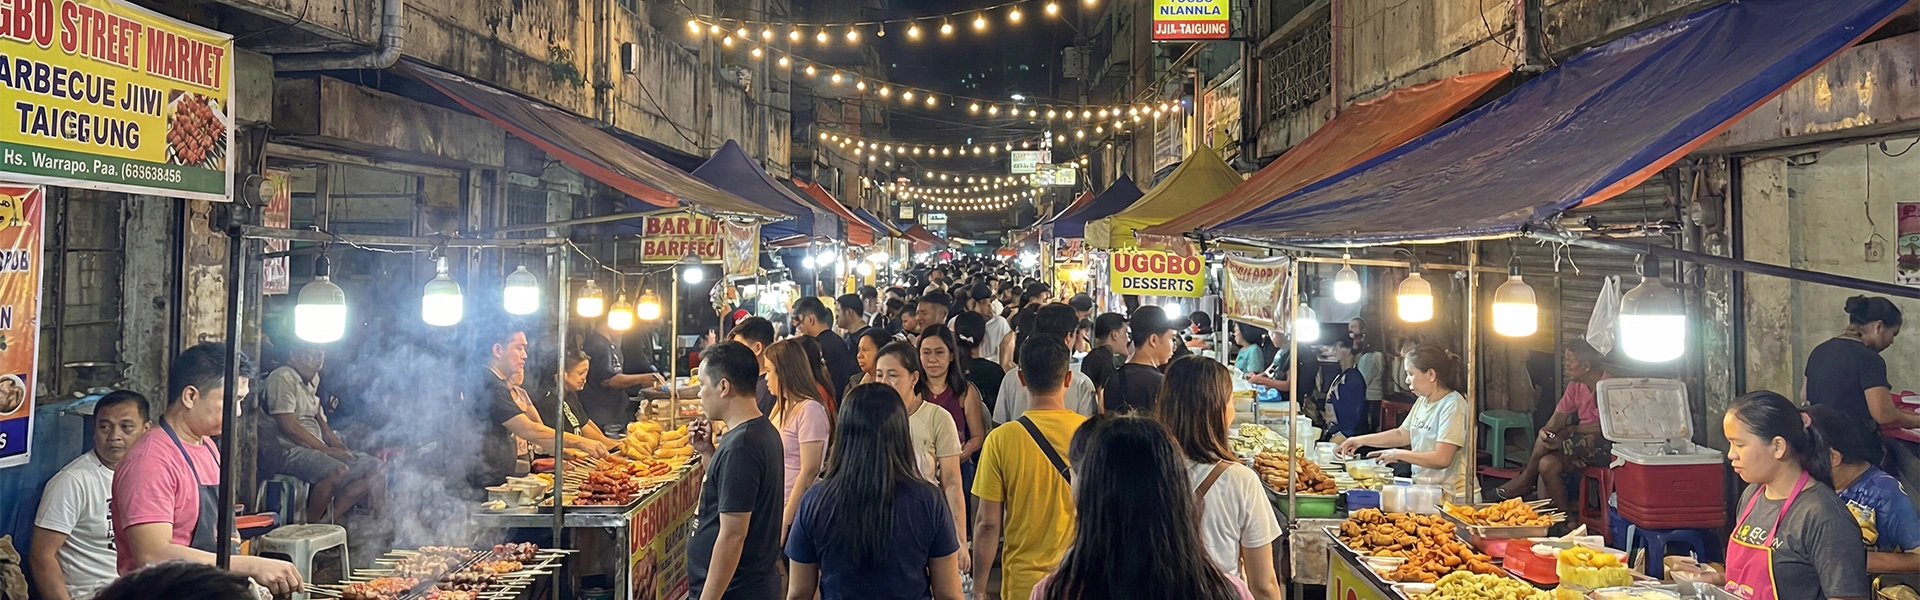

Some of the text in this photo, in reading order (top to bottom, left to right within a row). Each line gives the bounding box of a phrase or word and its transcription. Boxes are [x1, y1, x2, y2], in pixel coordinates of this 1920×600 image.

[60, 0, 142, 69] STREET
[146, 26, 225, 88] MARKET
[32, 151, 89, 175] Warrapo.
[93, 160, 118, 176] Paa.
[1123, 277, 1194, 292] DESSERTS
